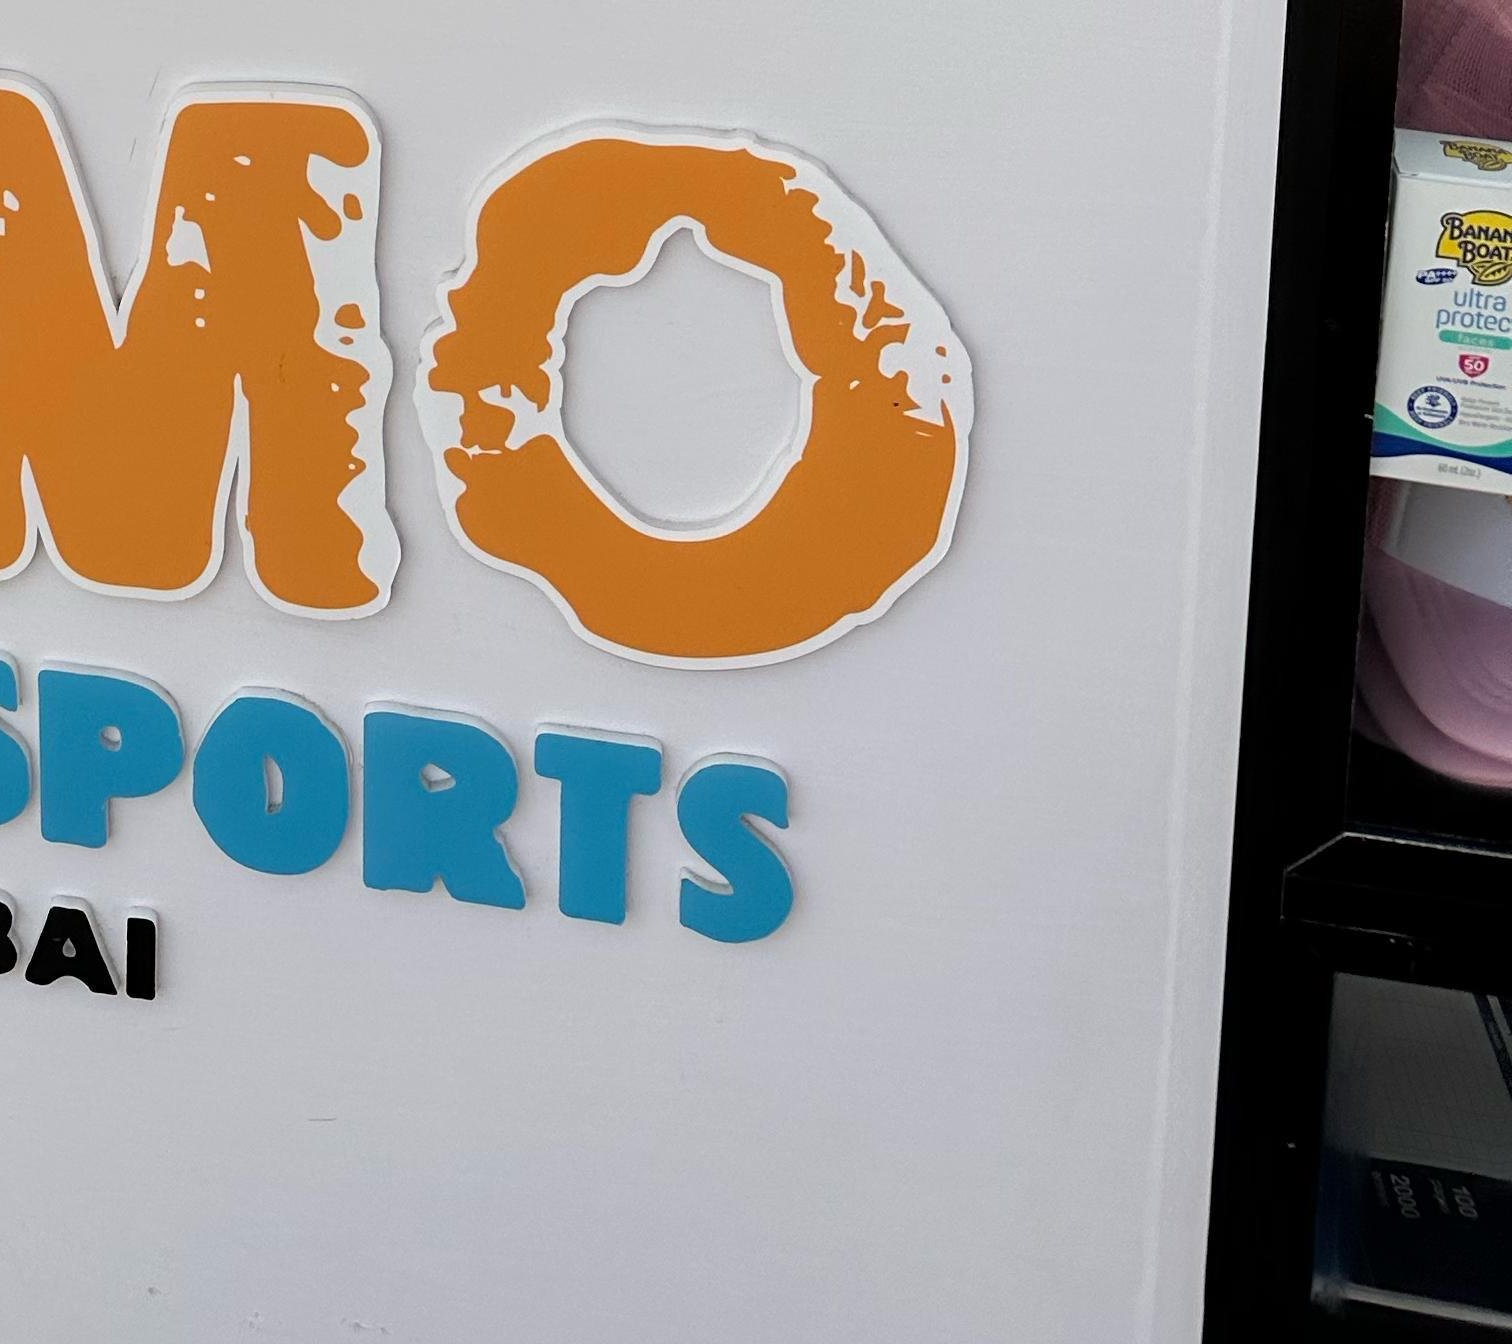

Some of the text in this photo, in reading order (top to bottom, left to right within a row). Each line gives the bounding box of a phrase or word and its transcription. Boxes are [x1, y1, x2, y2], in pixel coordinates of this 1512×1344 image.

[1458, 234, 1512, 263] BOAT
[1453, 288, 1507, 312] ultra
[1436, 309, 1512, 333] protec
[1464, 358, 1485, 372] 50
